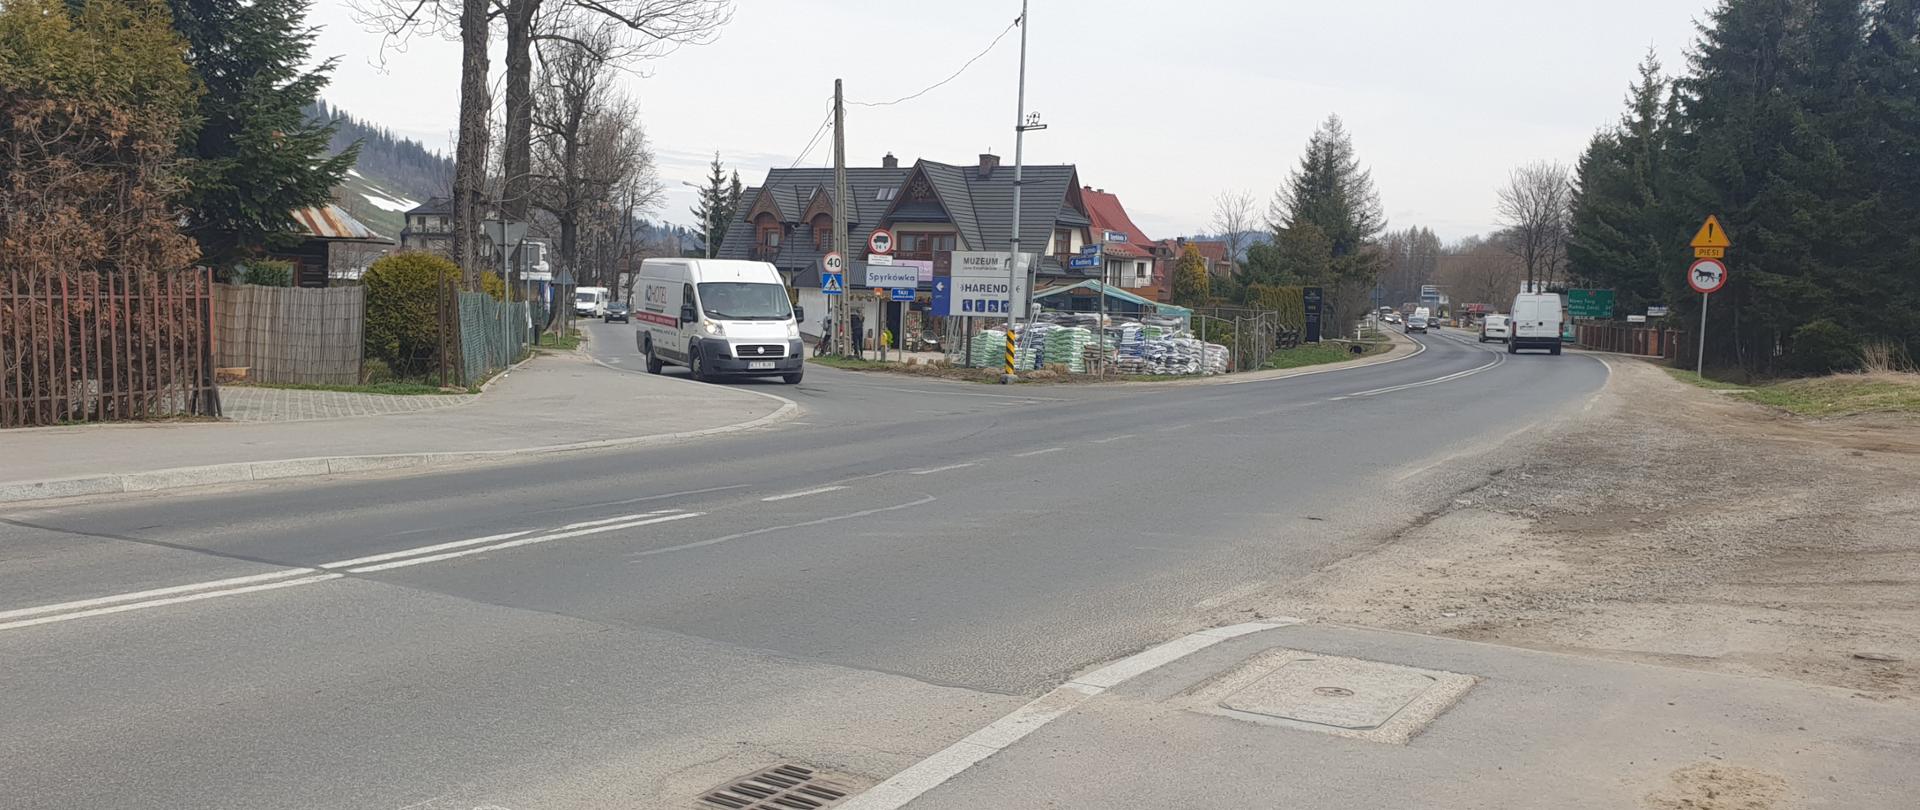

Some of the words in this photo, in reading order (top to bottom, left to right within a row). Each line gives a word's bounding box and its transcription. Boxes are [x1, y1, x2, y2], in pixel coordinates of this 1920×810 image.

[827, 257, 841, 268] 40
[963, 257, 998, 265] MUZEUM
[868, 272, 915, 283] Spyrkówka
[965, 283, 1009, 293] HAREND
